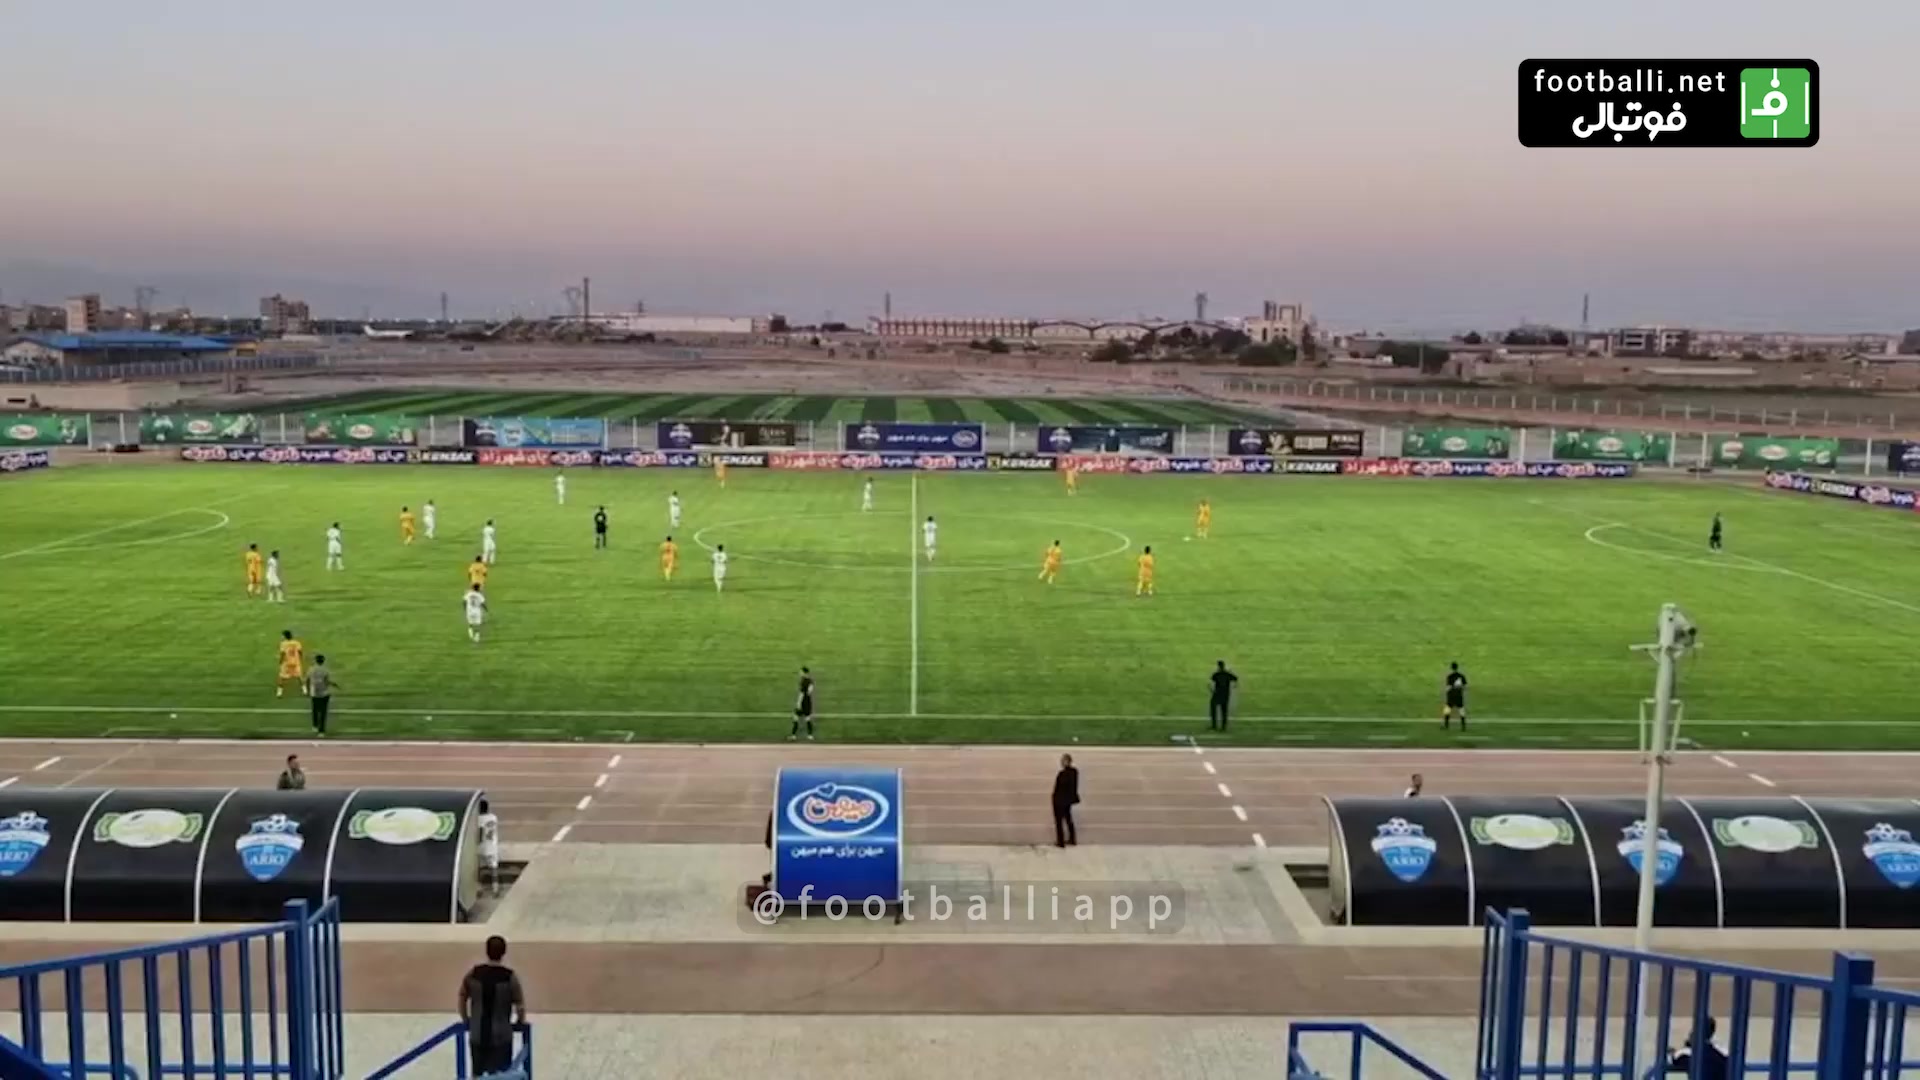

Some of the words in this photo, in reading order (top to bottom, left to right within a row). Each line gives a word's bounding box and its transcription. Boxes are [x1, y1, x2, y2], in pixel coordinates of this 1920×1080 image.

[803, 794, 876, 823] میهن
[791, 846, 817, 859] میهن
[857, 846, 885, 858] میهن
